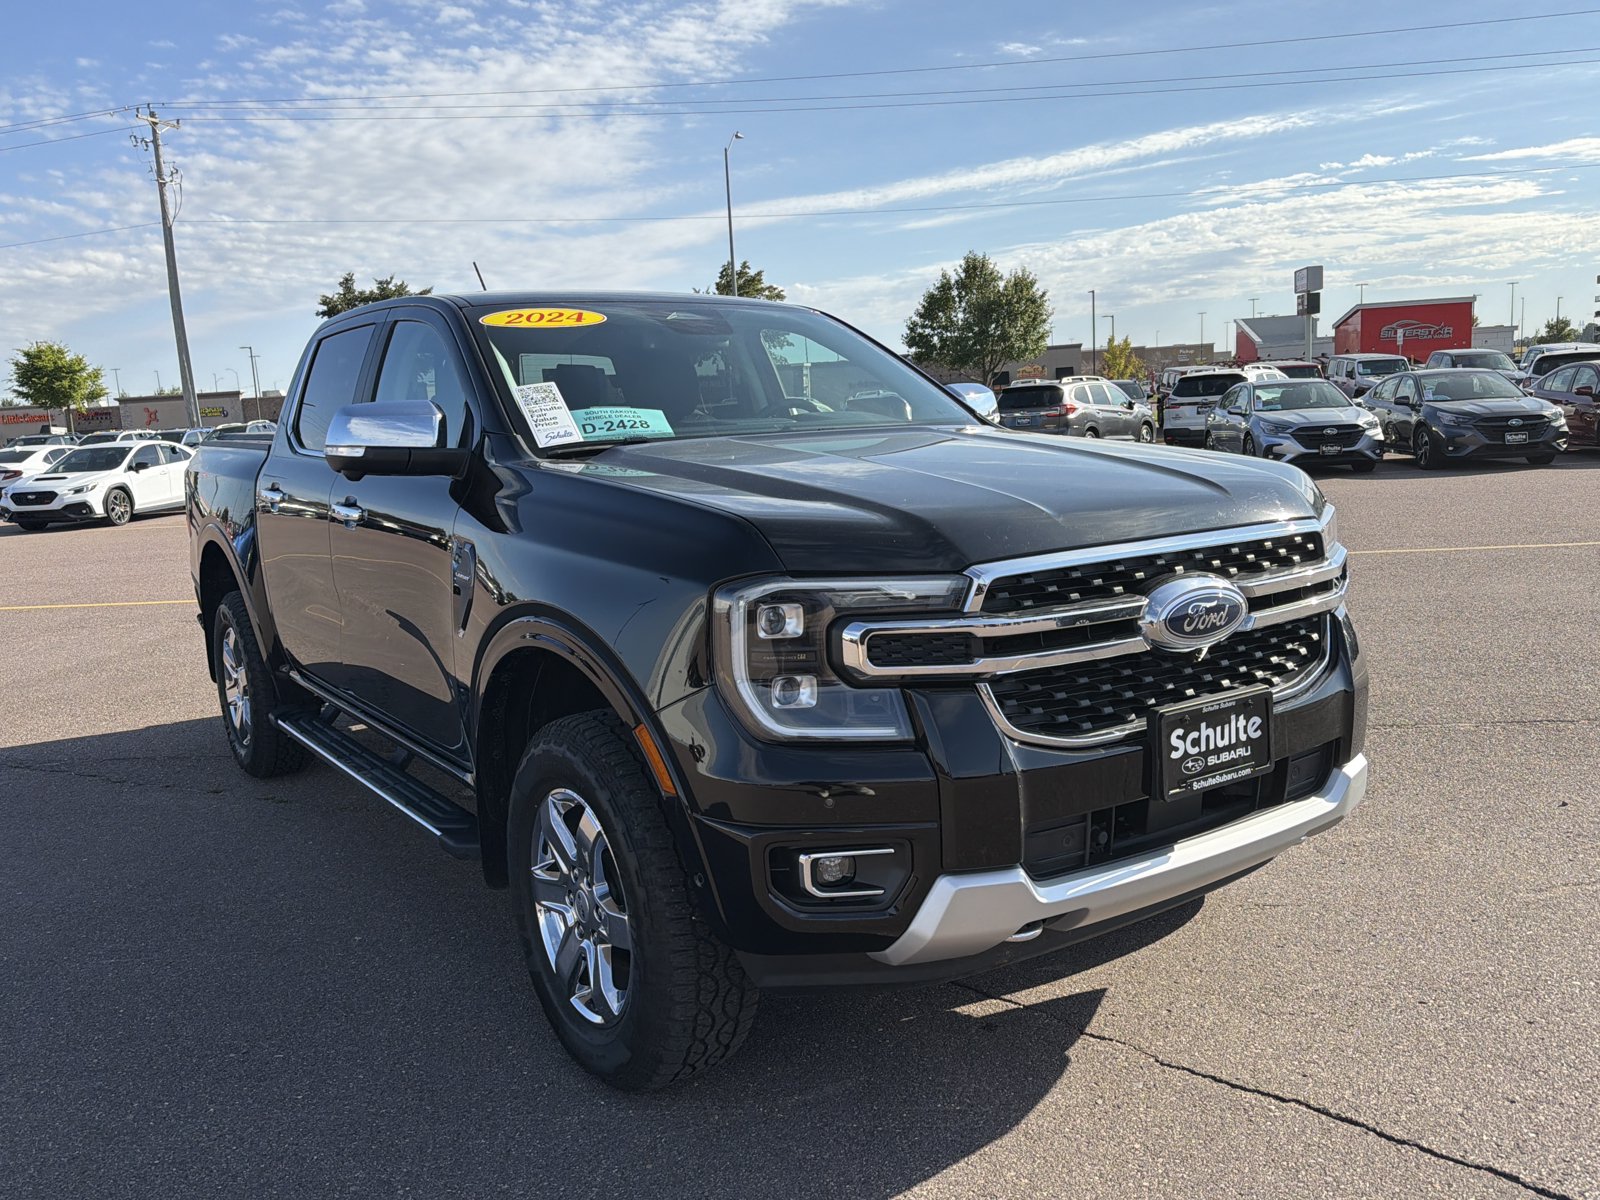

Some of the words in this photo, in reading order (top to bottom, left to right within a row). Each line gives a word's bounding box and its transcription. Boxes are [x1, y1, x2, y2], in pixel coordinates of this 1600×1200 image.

[505, 312, 585, 325] 2024
[529, 405, 562, 414] Schulte
[581, 419, 651, 434] D-2428
[1183, 600, 1230, 633] Ford
[1202, 705, 1220, 713] Schulte
[1219, 700, 1237, 709] Subaru
[1170, 713, 1263, 759] Schulte
[1207, 745, 1251, 766] SUBARU
[1192, 767, 1252, 790] SchulteSubaru.com
